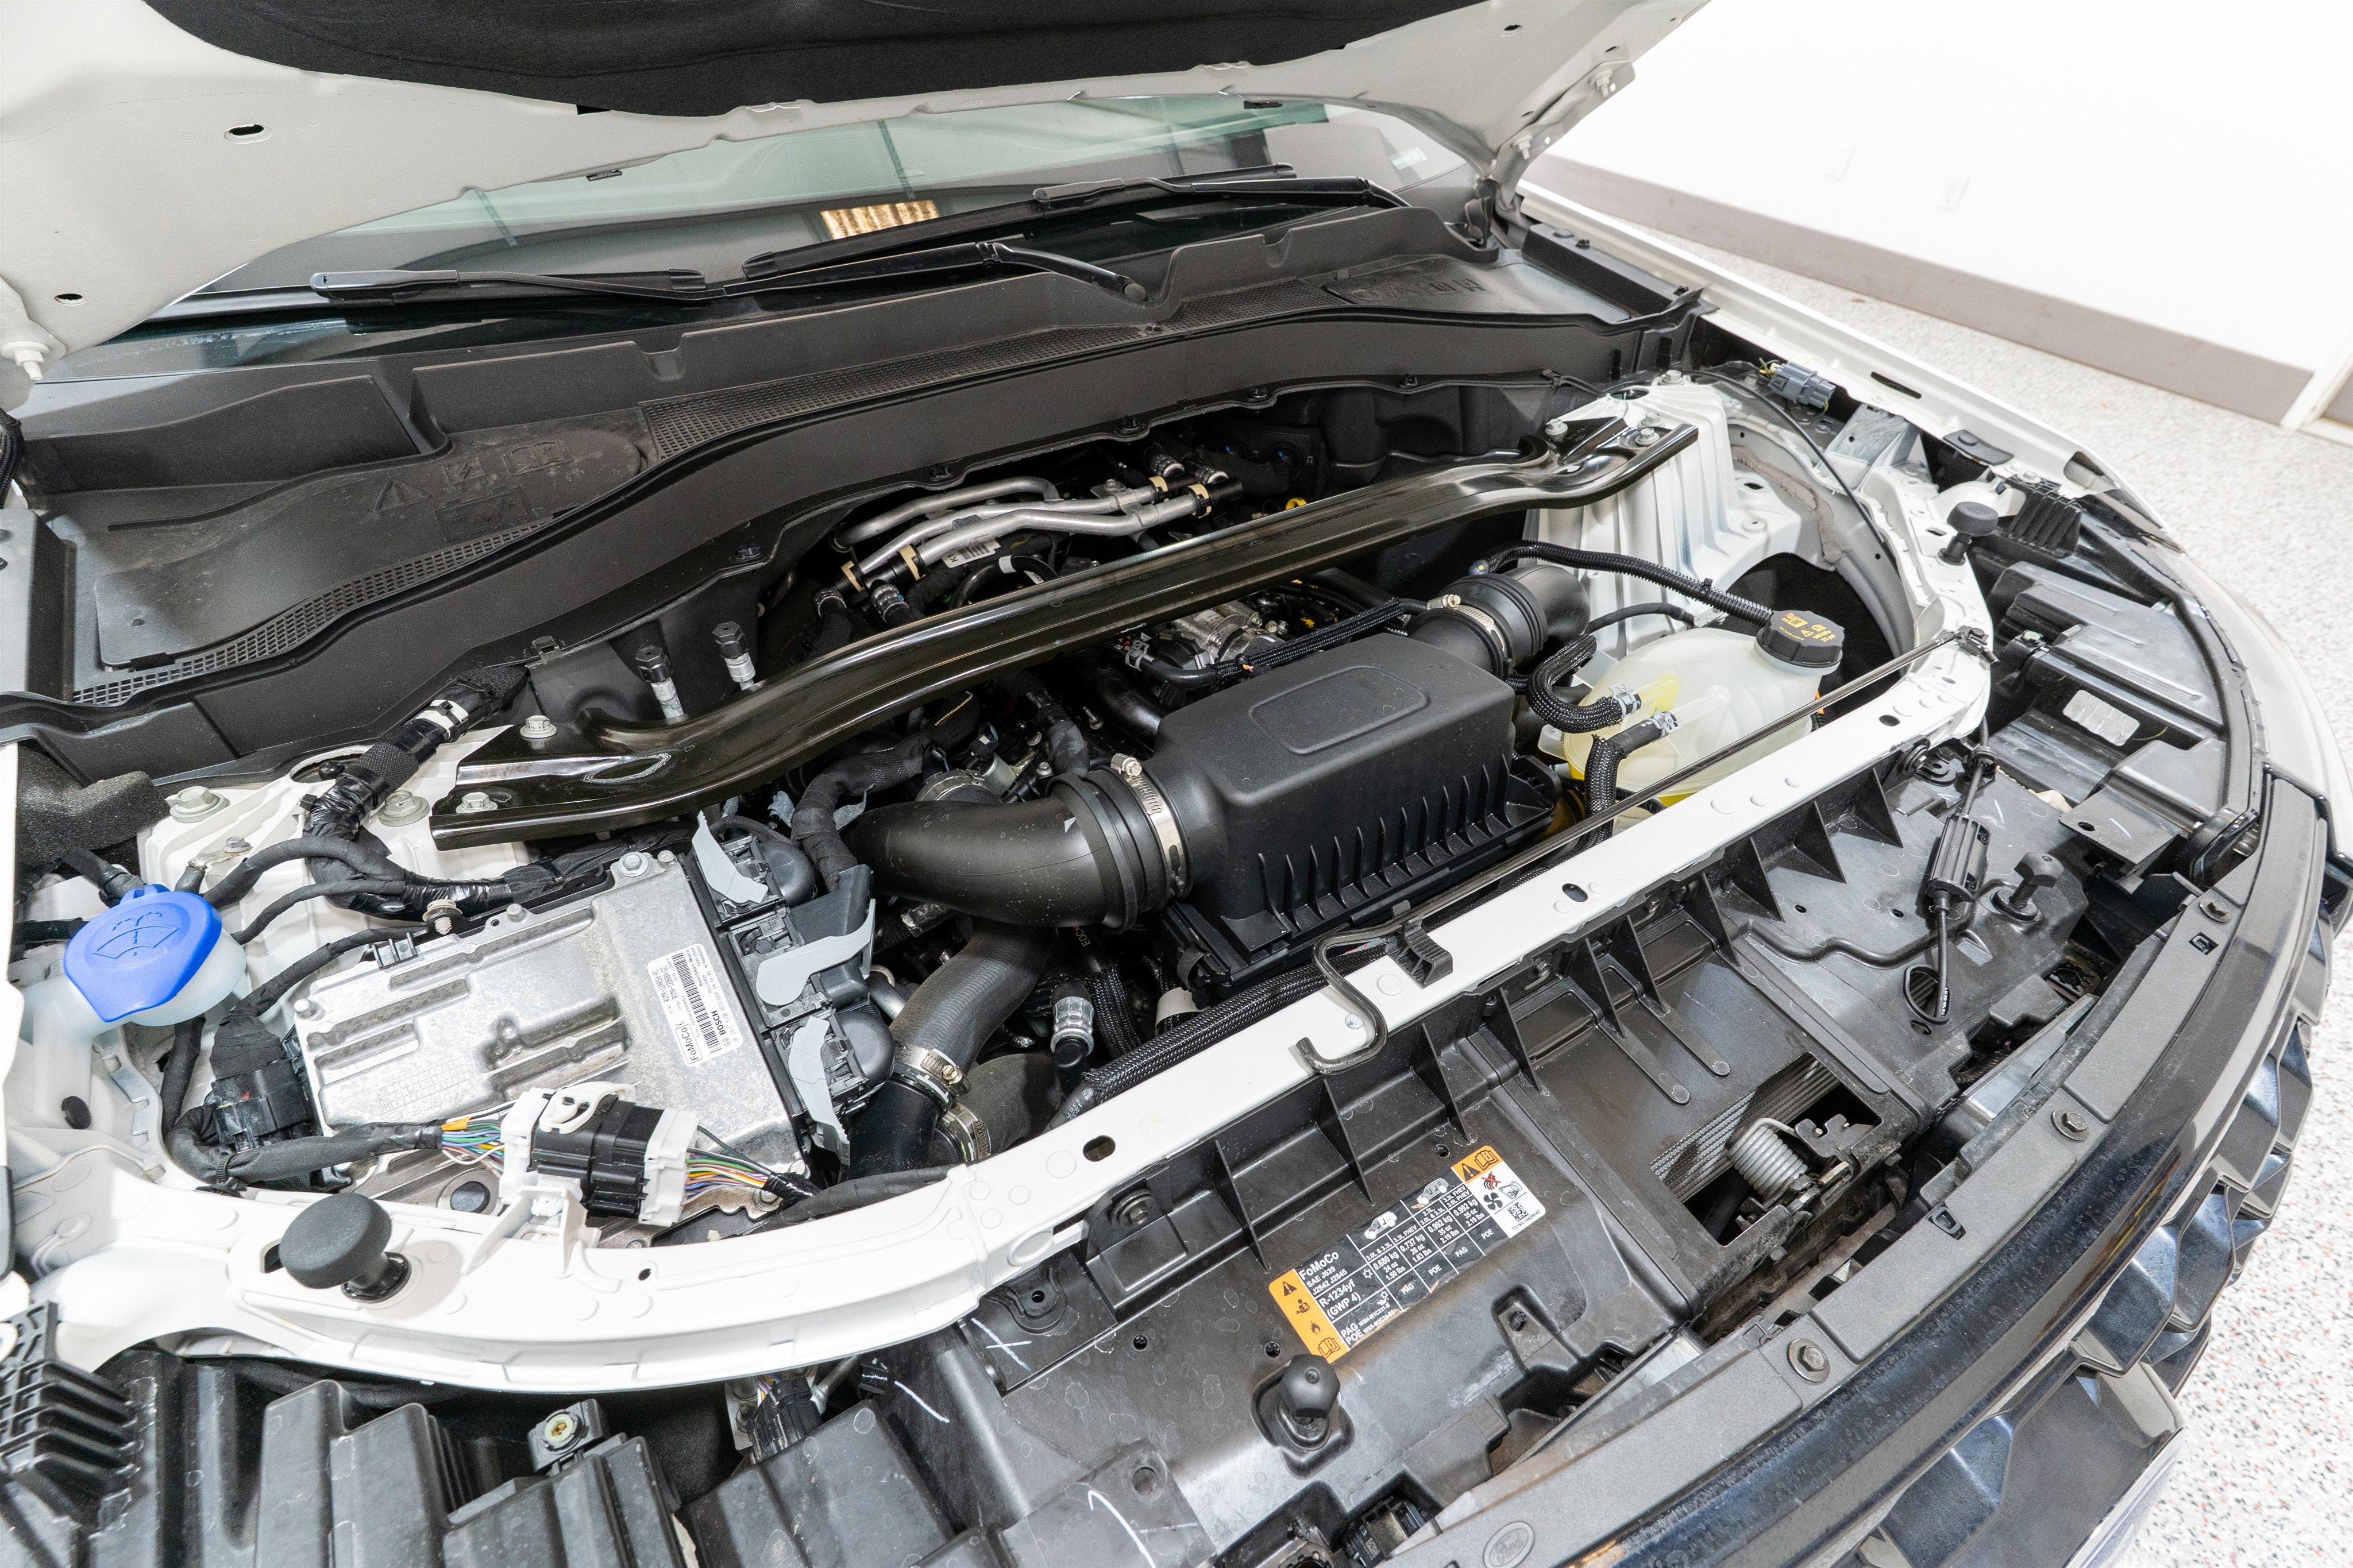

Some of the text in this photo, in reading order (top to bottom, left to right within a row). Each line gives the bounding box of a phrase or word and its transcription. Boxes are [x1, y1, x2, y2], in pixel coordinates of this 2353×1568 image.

[692, 967, 703, 986] Assembled
[711, 1011, 726, 1035] BOSCH
[681, 1027, 699, 1061] FoMoCo
[1442, 1185, 1466, 1203] 3.3L FHEV
[1446, 1189, 1470, 1208] 3.0L PHEV
[1453, 1198, 1479, 1216] 0.992 kg
[1463, 1211, 1472, 1219] 35
[1419, 1216, 1432, 1226] 3.0L
[1433, 1207, 1446, 1216] 3.3L
[1427, 1215, 1453, 1233] 0.992 kg
[1465, 1212, 1485, 1227] 2.19 lbs
[1392, 1224, 1417, 1243] 3.3L FHEV
[1437, 1227, 1446, 1236] 35
[1440, 1229, 1460, 1244] 2.19 lbs
[1480, 1229, 1494, 1239] POE
[1365, 1252, 1380, 1262] 3.0L
[1380, 1242, 1392, 1253] 3.3L
[1399, 1234, 1426, 1252] 0.737 kg
[1410, 1247, 1418, 1256] 26
[1455, 1246, 1468, 1258] PAG
[1372, 1251, 1400, 1270] 0.680 kg
[1412, 1248, 1432, 1263] 1.63 lbs
[1298, 1252, 1339, 1280] FoMoCo
[1383, 1264, 1392, 1273] 24
[1386, 1266, 1406, 1281] 1.50 lbs
[1428, 1264, 1442, 1276] POE
[1306, 1266, 1336, 1288] SAE J639
[1313, 1268, 1348, 1295] J2842 J2845
[1318, 1279, 1356, 1308] R-1234yf
[1399, 1283, 1415, 1295] PAG
[1326, 1292, 1361, 1319] (GWP 4)
[1340, 1323, 1360, 1339] PAG
[1345, 1328, 1365, 1345] POE
[1494, 1534, 1523, 1566] Ford
